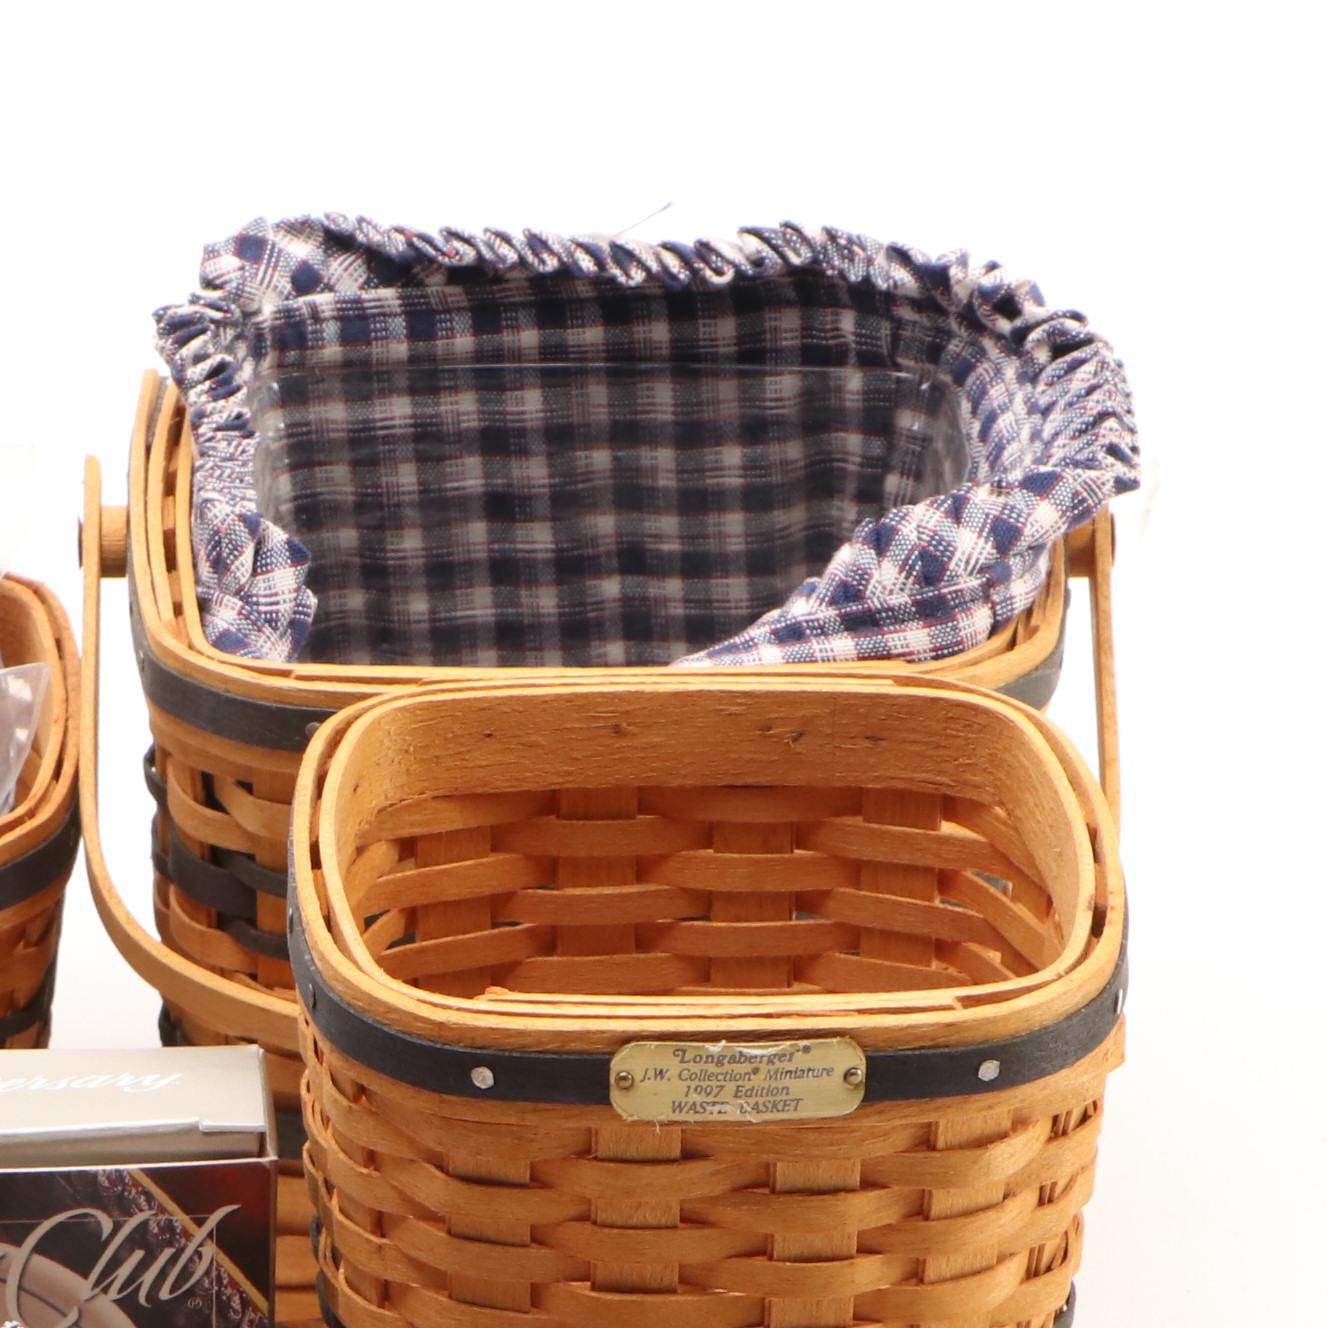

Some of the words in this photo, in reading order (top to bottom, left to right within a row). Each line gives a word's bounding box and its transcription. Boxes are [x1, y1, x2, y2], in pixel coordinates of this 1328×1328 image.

[639, 1068, 671, 1083] J.W.
[763, 1065, 835, 1081] Miniature
[684, 1084, 725, 1098] 1997
[733, 1084, 791, 1098] Edition
[739, 1098, 804, 1114] BASKET
